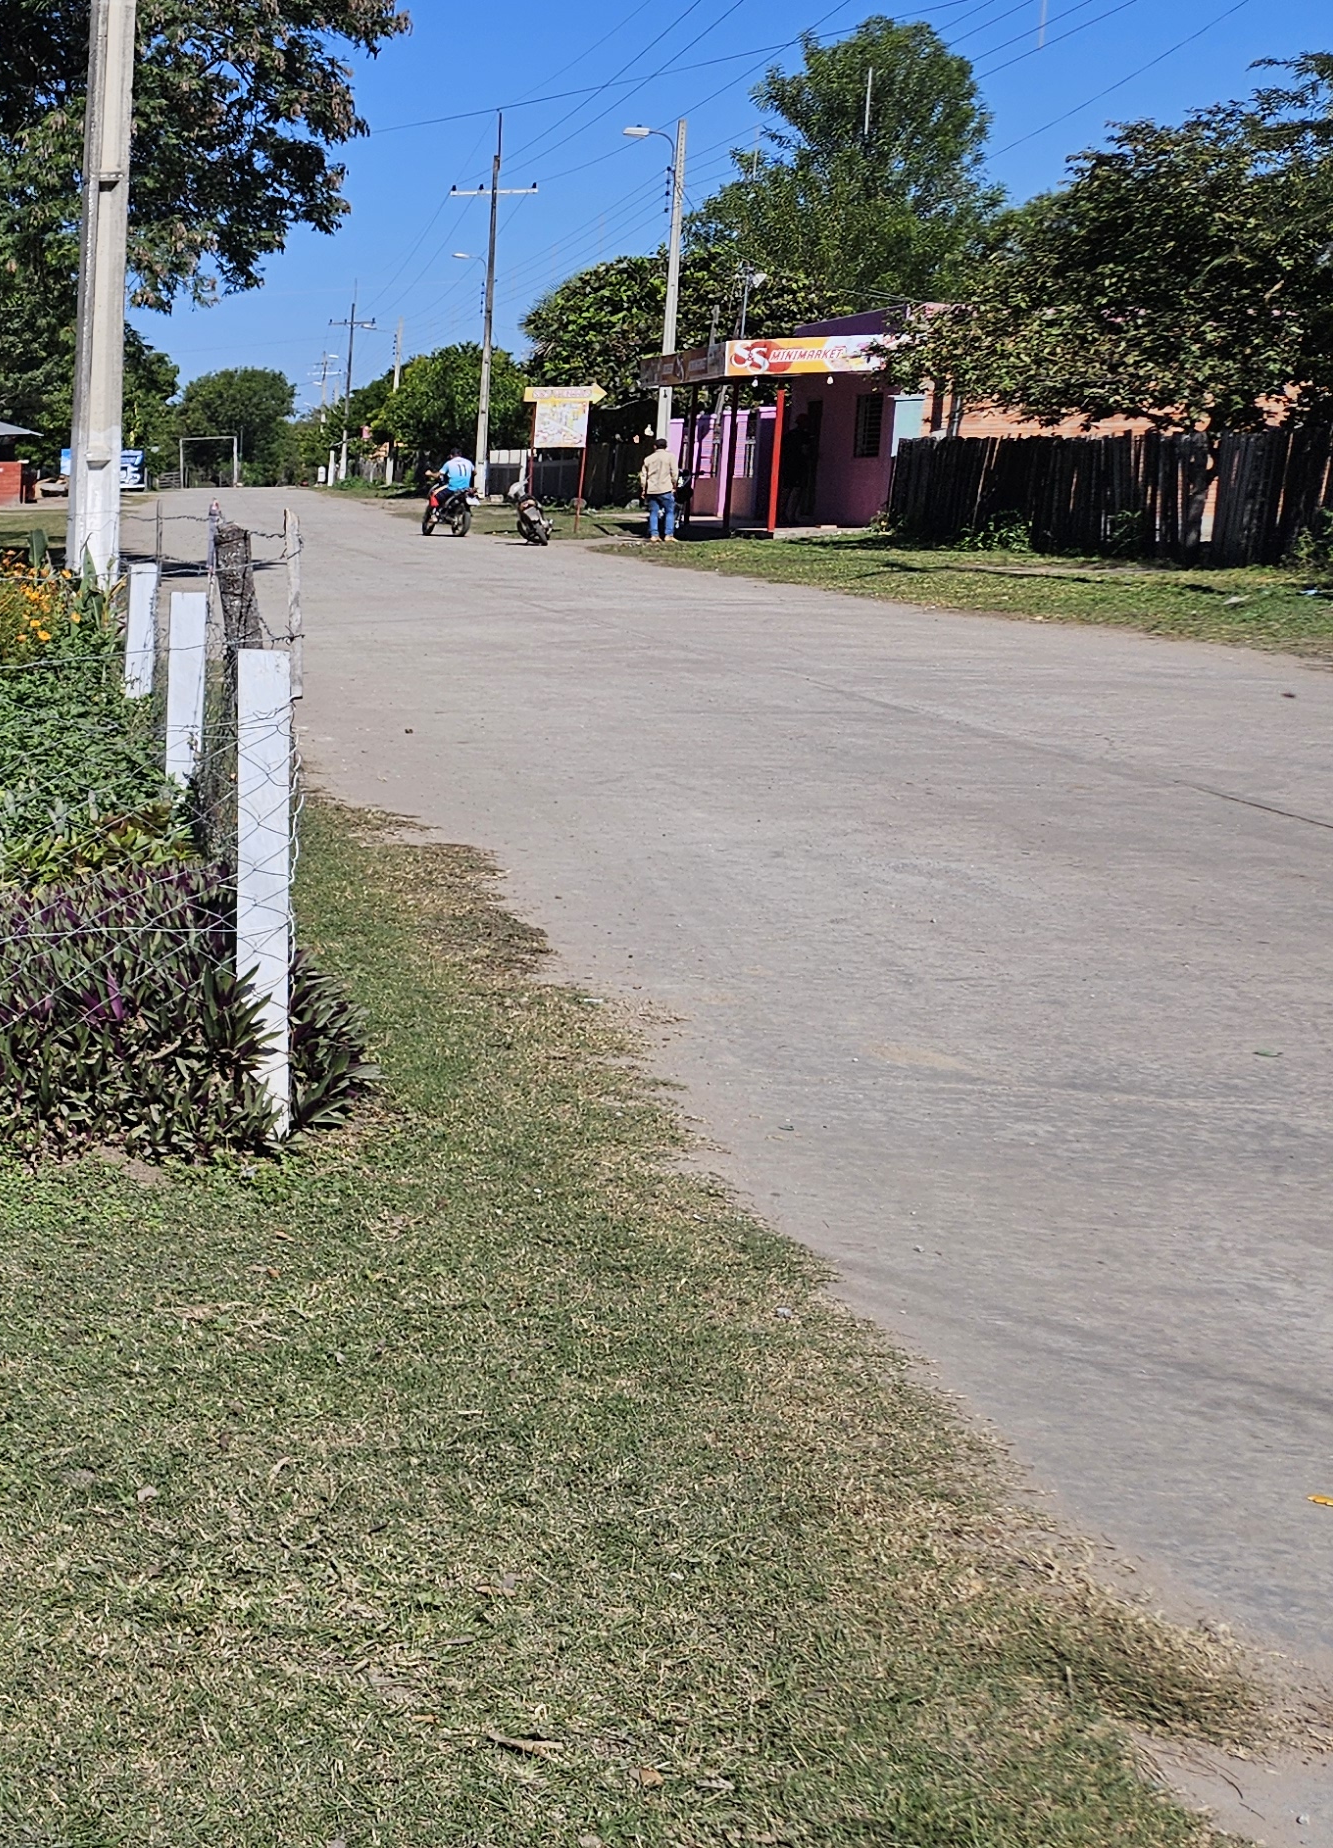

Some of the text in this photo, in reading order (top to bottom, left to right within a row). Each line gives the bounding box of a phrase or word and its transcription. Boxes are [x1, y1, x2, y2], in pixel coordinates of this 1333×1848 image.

[731, 342, 768, 375] S&S
[770, 348, 844, 363] MINIMARKET
[457, 463, 468, 477] 11
